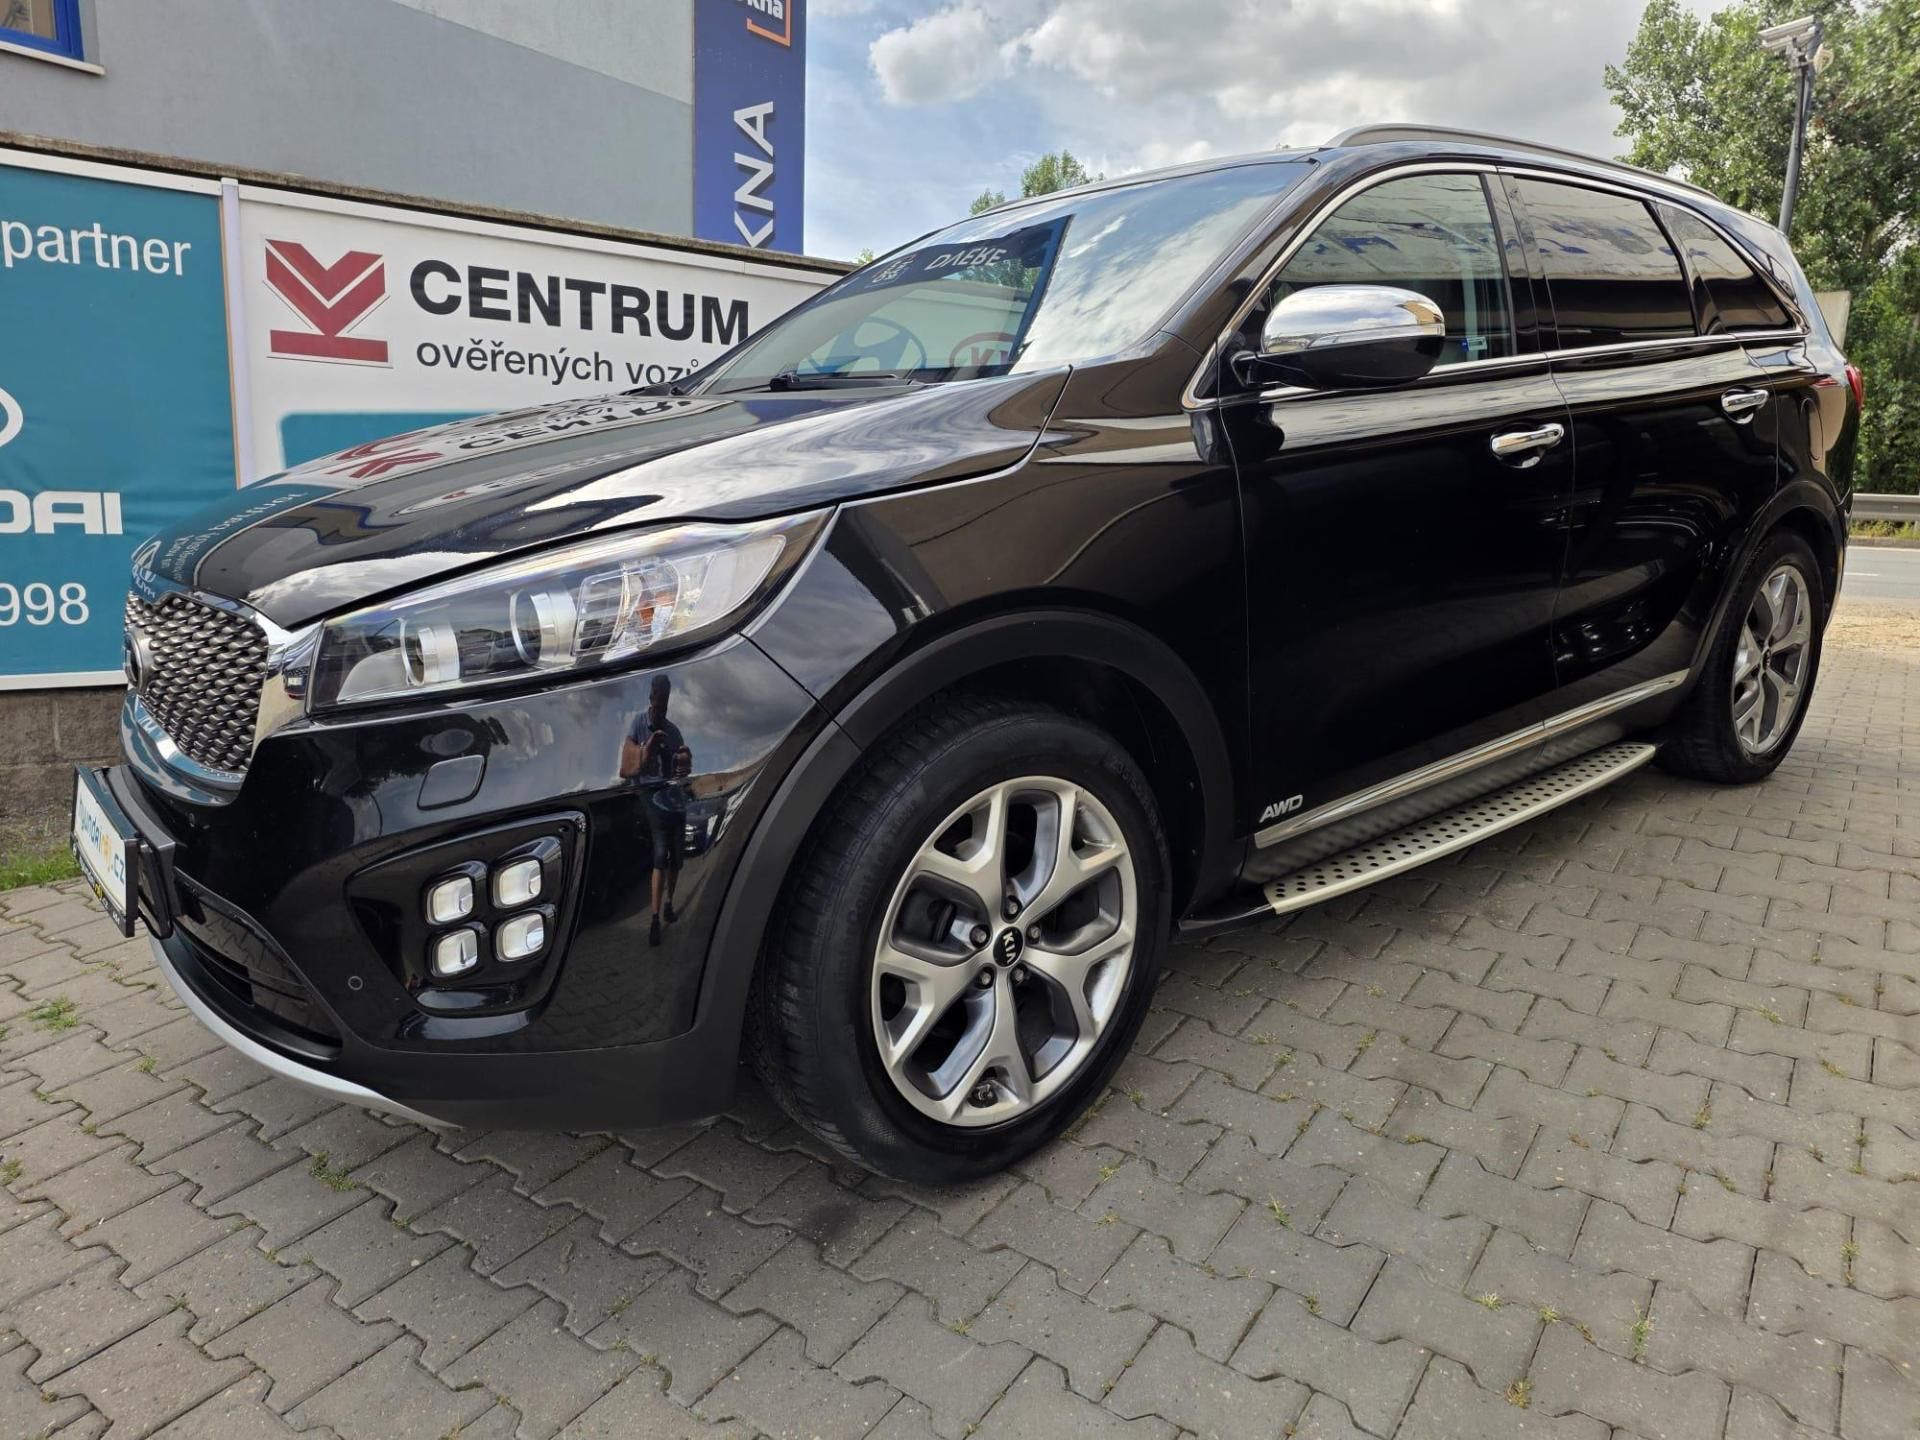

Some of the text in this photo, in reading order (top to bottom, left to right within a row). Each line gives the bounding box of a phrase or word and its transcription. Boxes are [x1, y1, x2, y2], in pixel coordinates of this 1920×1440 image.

[3, 220, 191, 276] partner
[410, 259, 749, 345] CENTRUM
[416, 337, 613, 386] ověřených
[0, 582, 89, 626] 998
[1258, 794, 1304, 824] AWD
[1002, 930, 1017, 965] KIA
